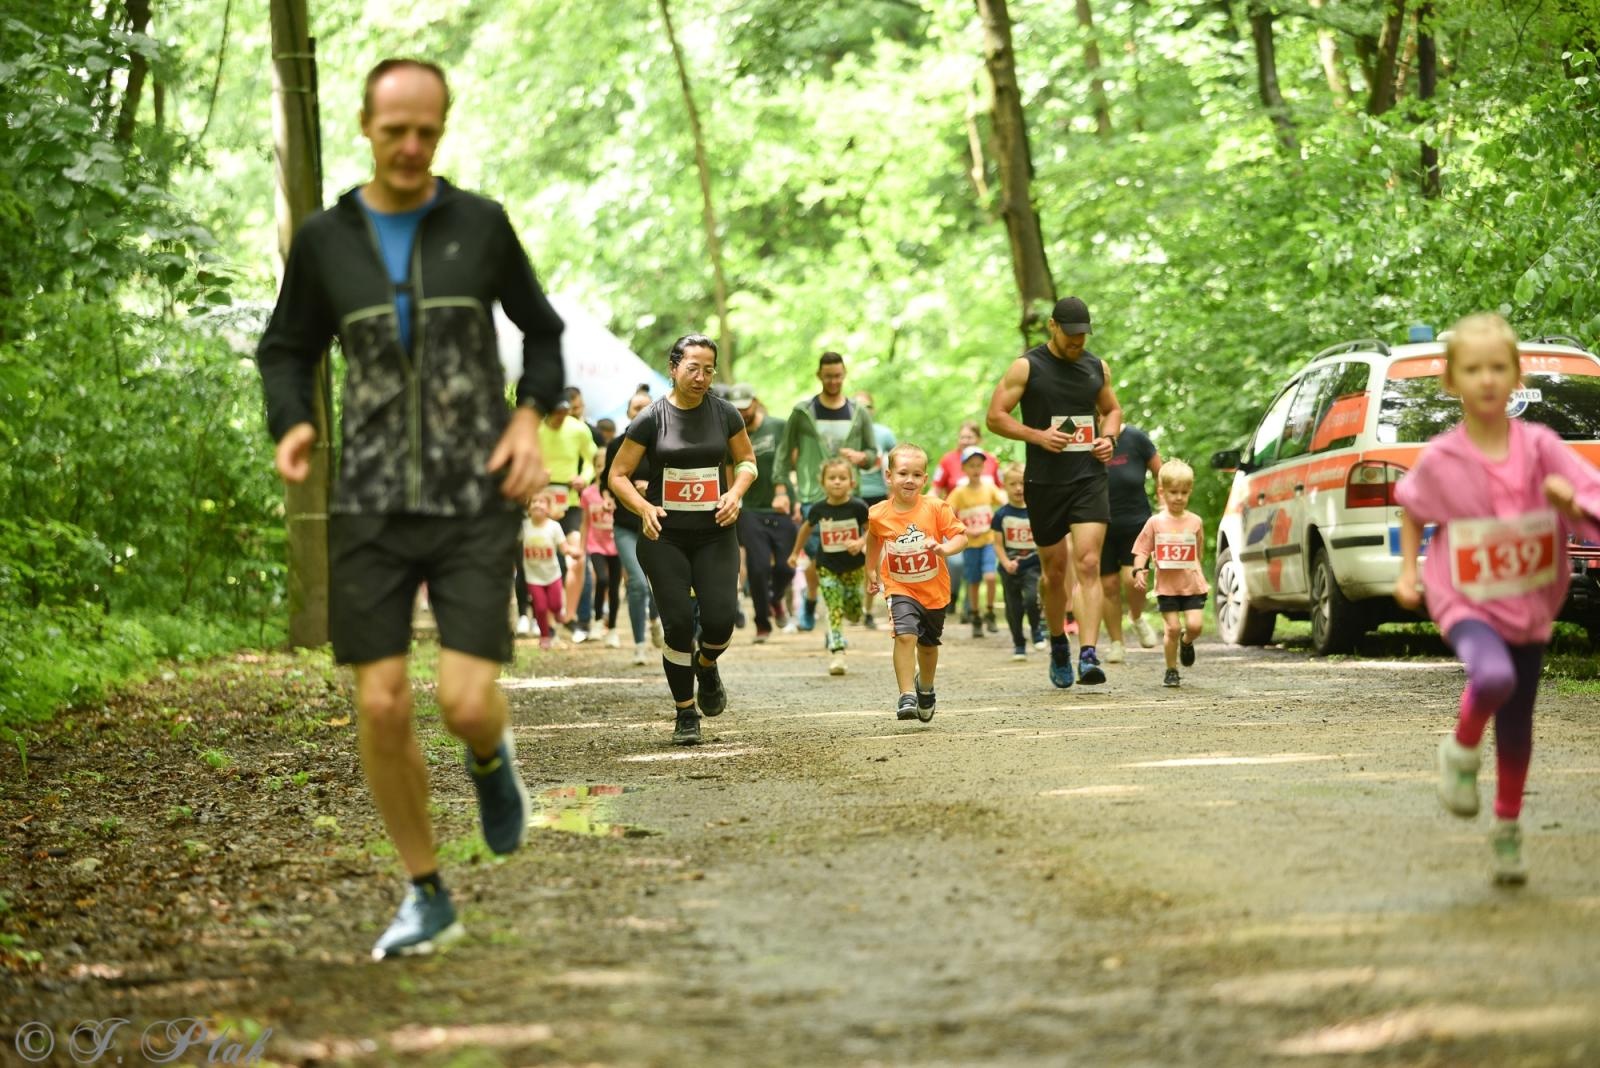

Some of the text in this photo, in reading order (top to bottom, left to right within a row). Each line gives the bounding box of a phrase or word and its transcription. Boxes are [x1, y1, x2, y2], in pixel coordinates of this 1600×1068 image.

[678, 483, 705, 501] 49
[826, 531, 852, 545] 122
[1161, 545, 1192, 561] 137
[1471, 540, 1543, 581] 139
[894, 554, 931, 574] 112
